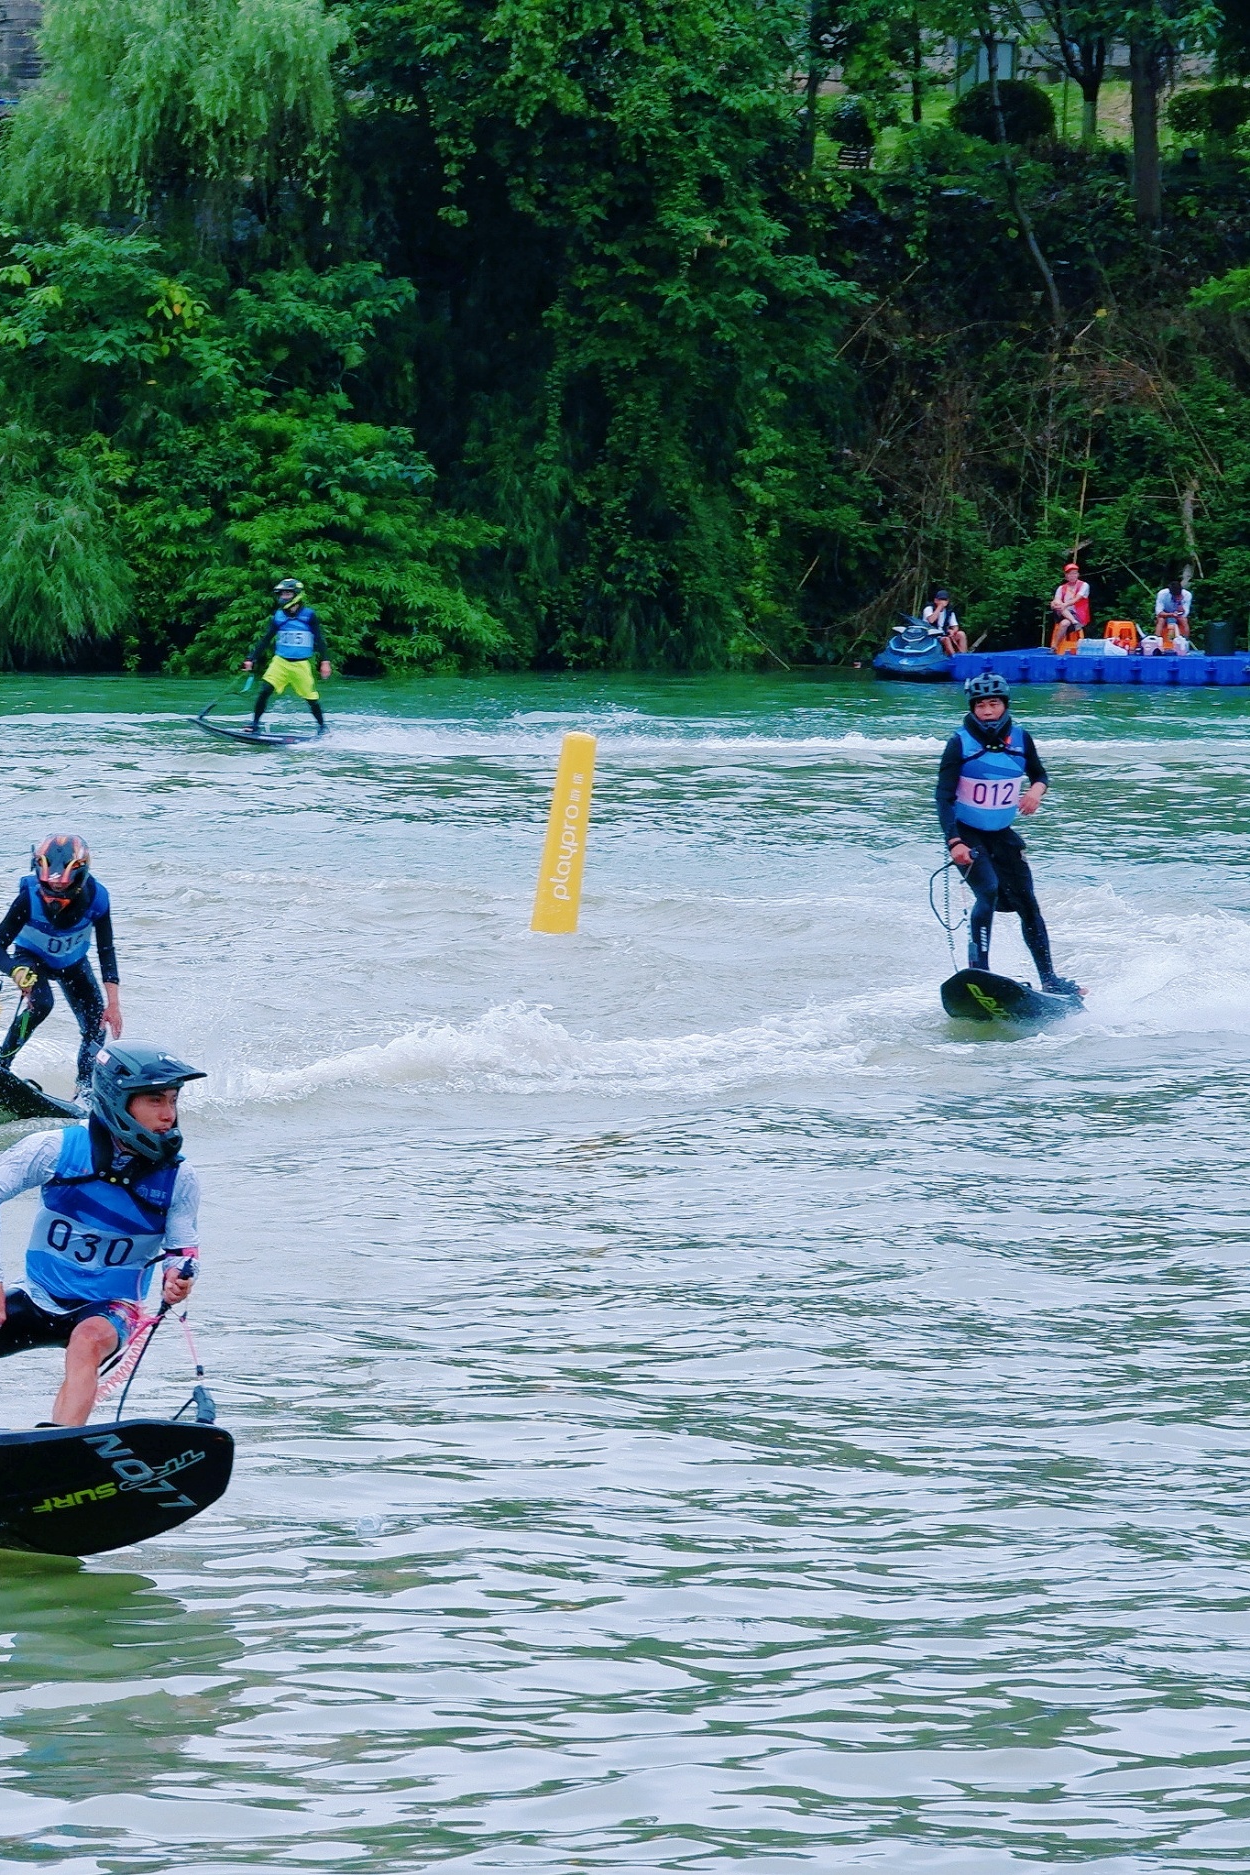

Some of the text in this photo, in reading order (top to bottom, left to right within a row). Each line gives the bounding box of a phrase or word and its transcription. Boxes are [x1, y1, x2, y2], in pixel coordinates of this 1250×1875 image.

[973, 782, 1014, 807] 012
[549, 804, 579, 901] playpro
[47, 1218, 134, 1267] 030
[33, 1481, 118, 1513] SURF
